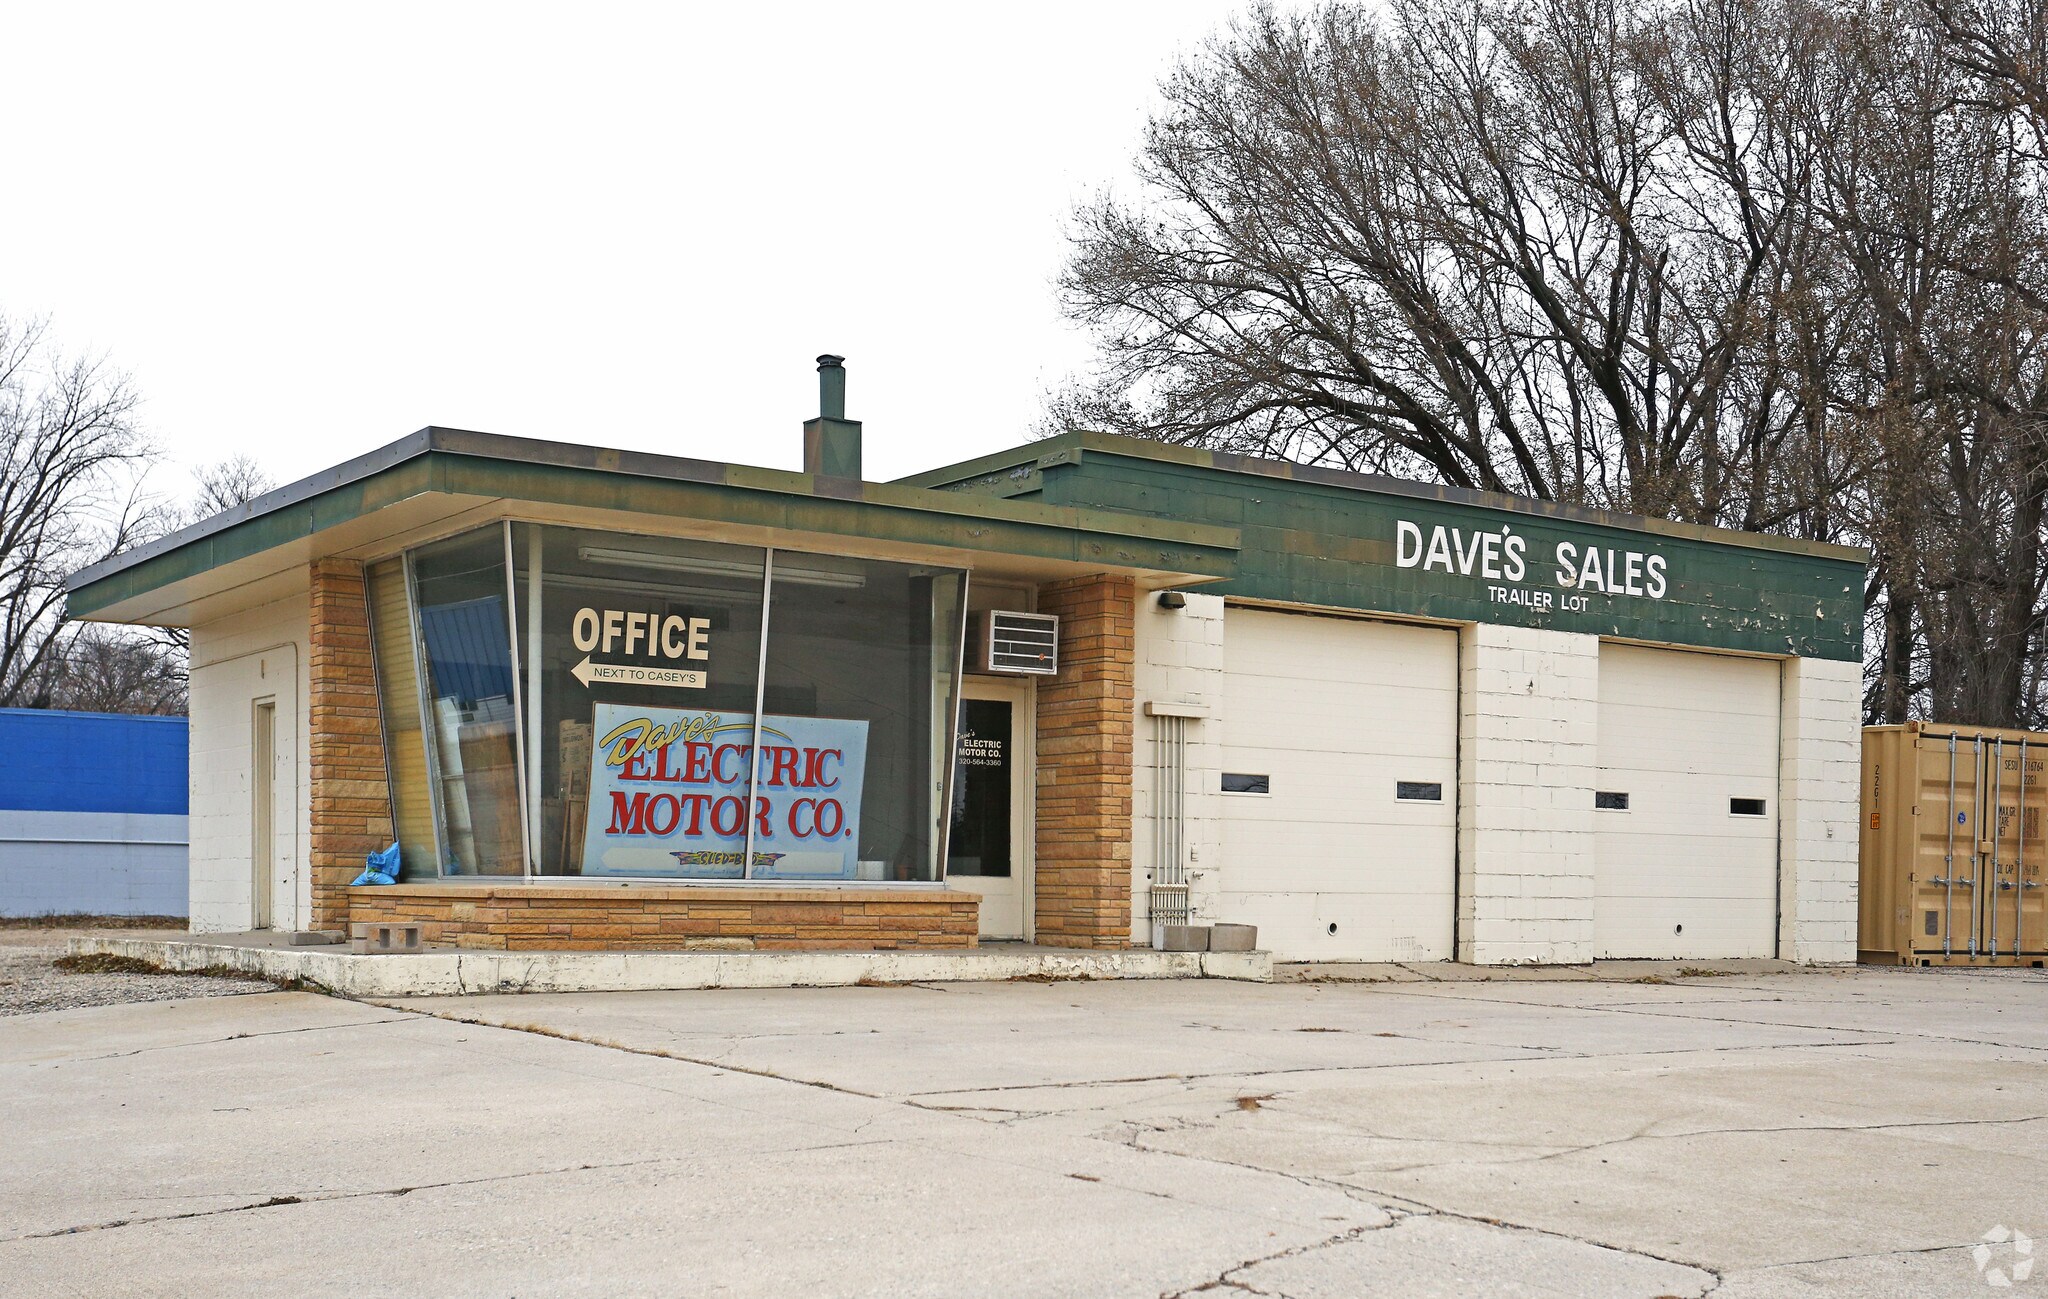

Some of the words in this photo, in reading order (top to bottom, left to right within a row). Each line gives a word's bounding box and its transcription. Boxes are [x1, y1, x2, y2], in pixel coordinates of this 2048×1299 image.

[1396, 520, 1526, 582] DAVE'S
[1555, 541, 1667, 599] SALES
[1488, 585, 1552, 609] TRAILER
[1561, 594, 1589, 612] LOT
[572, 607, 711, 660] OFFICE
[594, 667, 626, 679] NEXT
[629, 669, 645, 680] TO
[648, 671, 696, 683] CASEY'S
[600, 712, 721, 766] Dave's
[959, 748, 987, 757] MOTOR
[988, 750, 1002, 758] CO.
[964, 739, 1002, 749] ELECTRIC
[617, 738, 841, 788] ELECTRIC
[959, 758, 1002, 767] 320-564-3360
[605, 791, 773, 837] MOTOR
[788, 797, 852, 838] CO.
